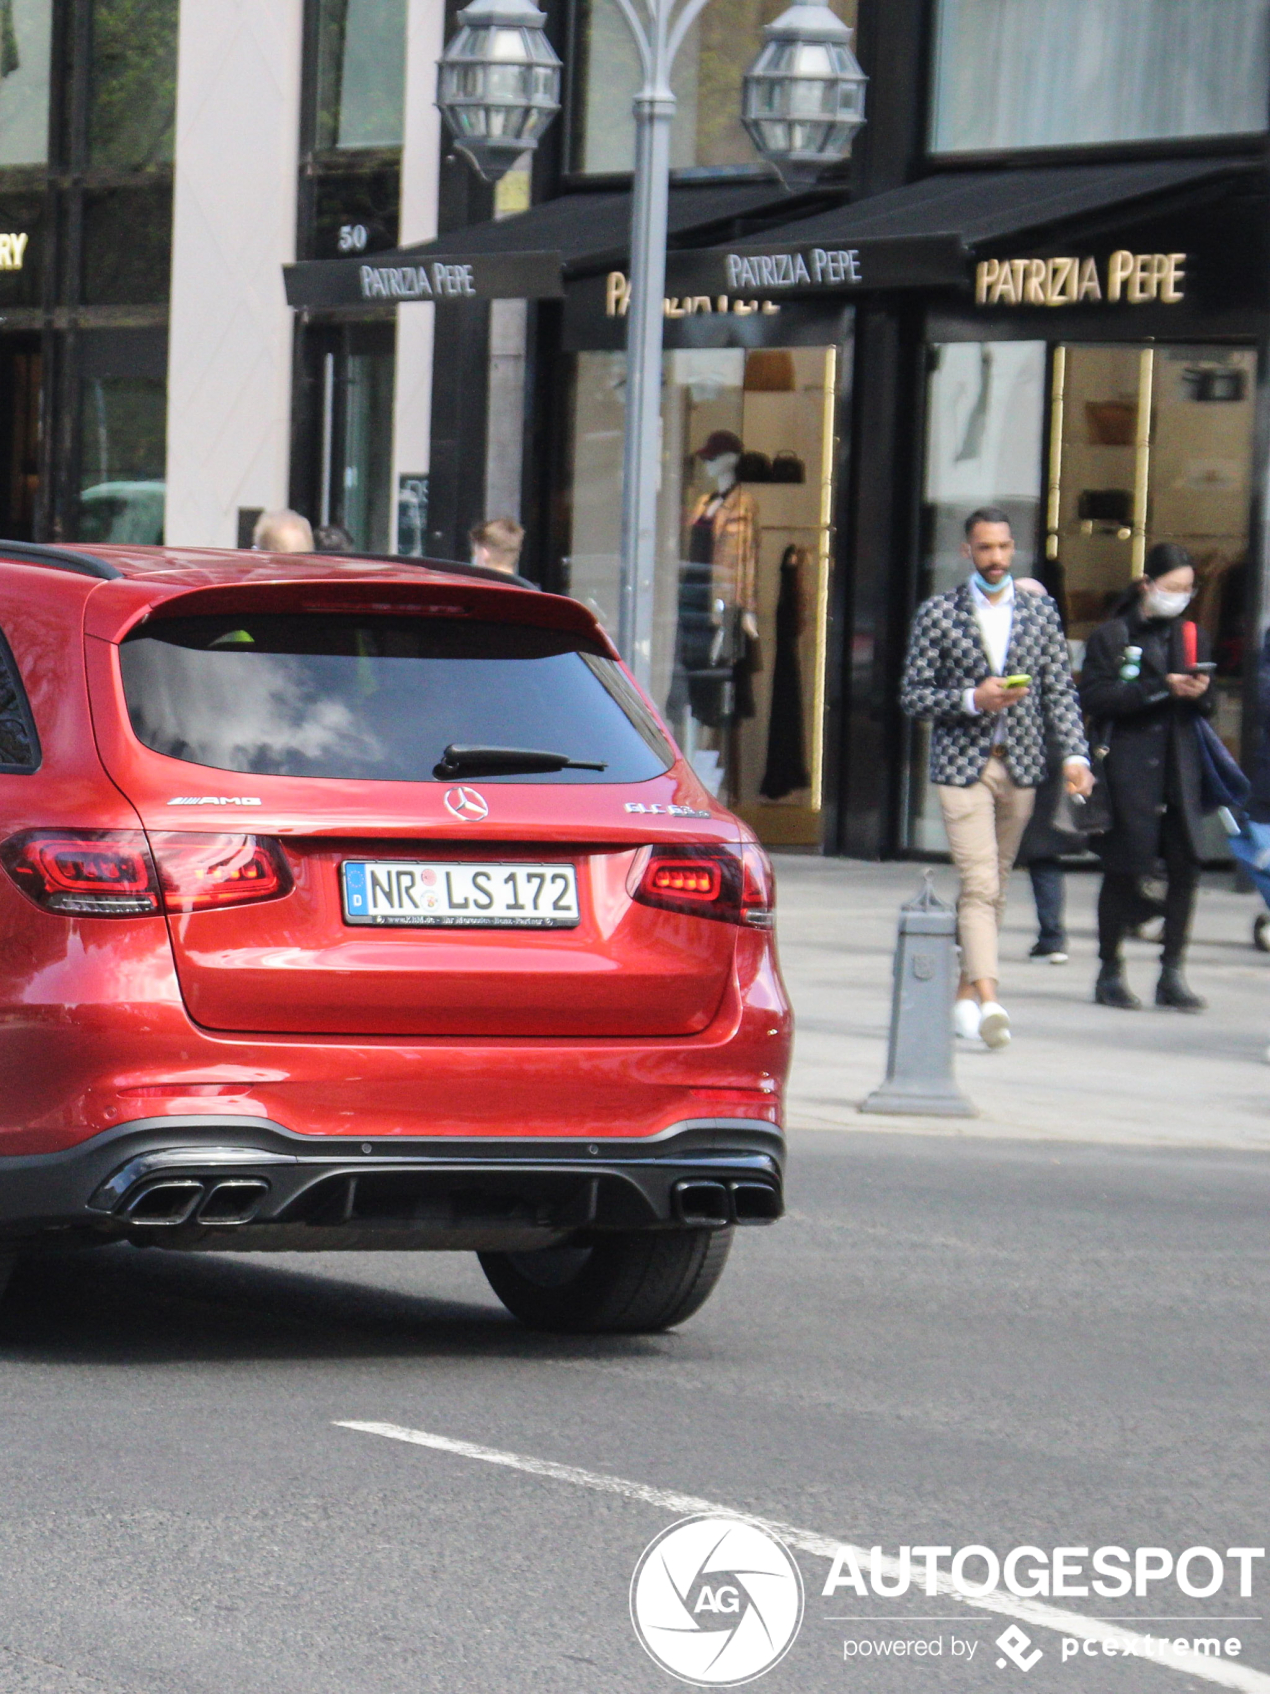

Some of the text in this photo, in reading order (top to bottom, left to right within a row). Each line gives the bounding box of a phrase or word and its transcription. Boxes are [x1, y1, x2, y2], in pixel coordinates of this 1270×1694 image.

[339, 224, 368, 250] 50
[360, 262, 476, 297] PATRIZIA PEPE
[726, 248, 863, 289] PATRIZIA PEPE
[976, 250, 1187, 306] PATRIZIA PEPE
[198, 796, 262, 806] AMG
[624, 802, 667, 815] GLC
[353, 894, 362, 907] D
[370, 869, 420, 909] NR
